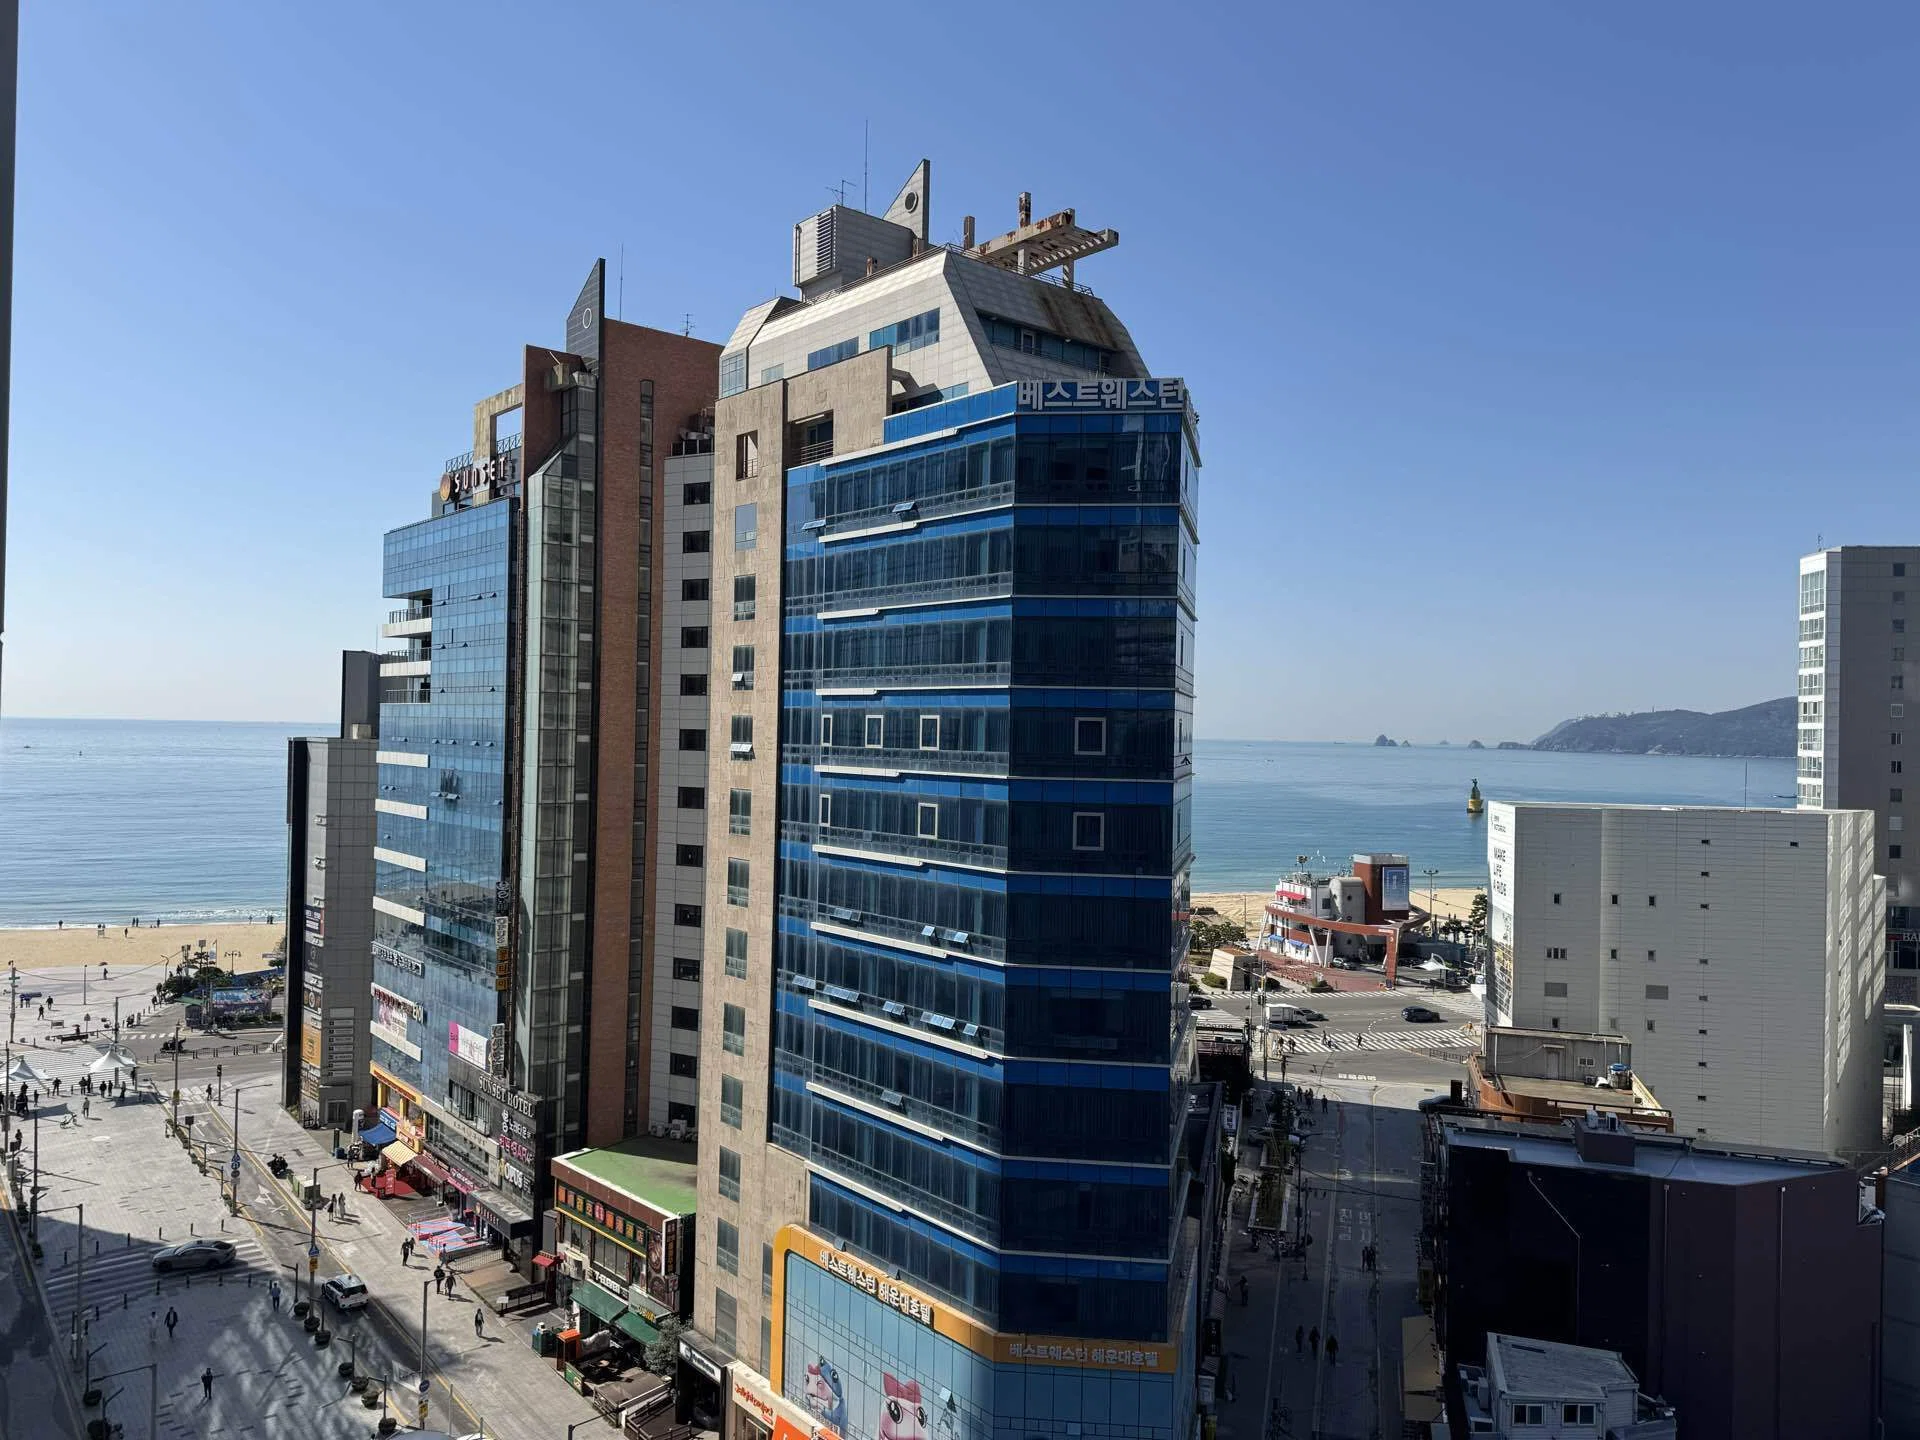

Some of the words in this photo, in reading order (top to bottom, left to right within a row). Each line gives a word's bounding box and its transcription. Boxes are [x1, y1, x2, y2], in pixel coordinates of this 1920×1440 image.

[1018, 378, 1184, 410] 베스트웨스턴
[1902, 932, 1920, 942] BA
[479, 1075, 506, 1104] SUNSET
[507, 1091, 534, 1118] HOTEL
[820, 1250, 877, 1294] 베스트웨스턴
[878, 1282, 931, 1325] 해운대호텔
[1009, 1343, 1088, 1362] 베스트웨스턴
[1091, 1348, 1159, 1367] 해운대호텔
